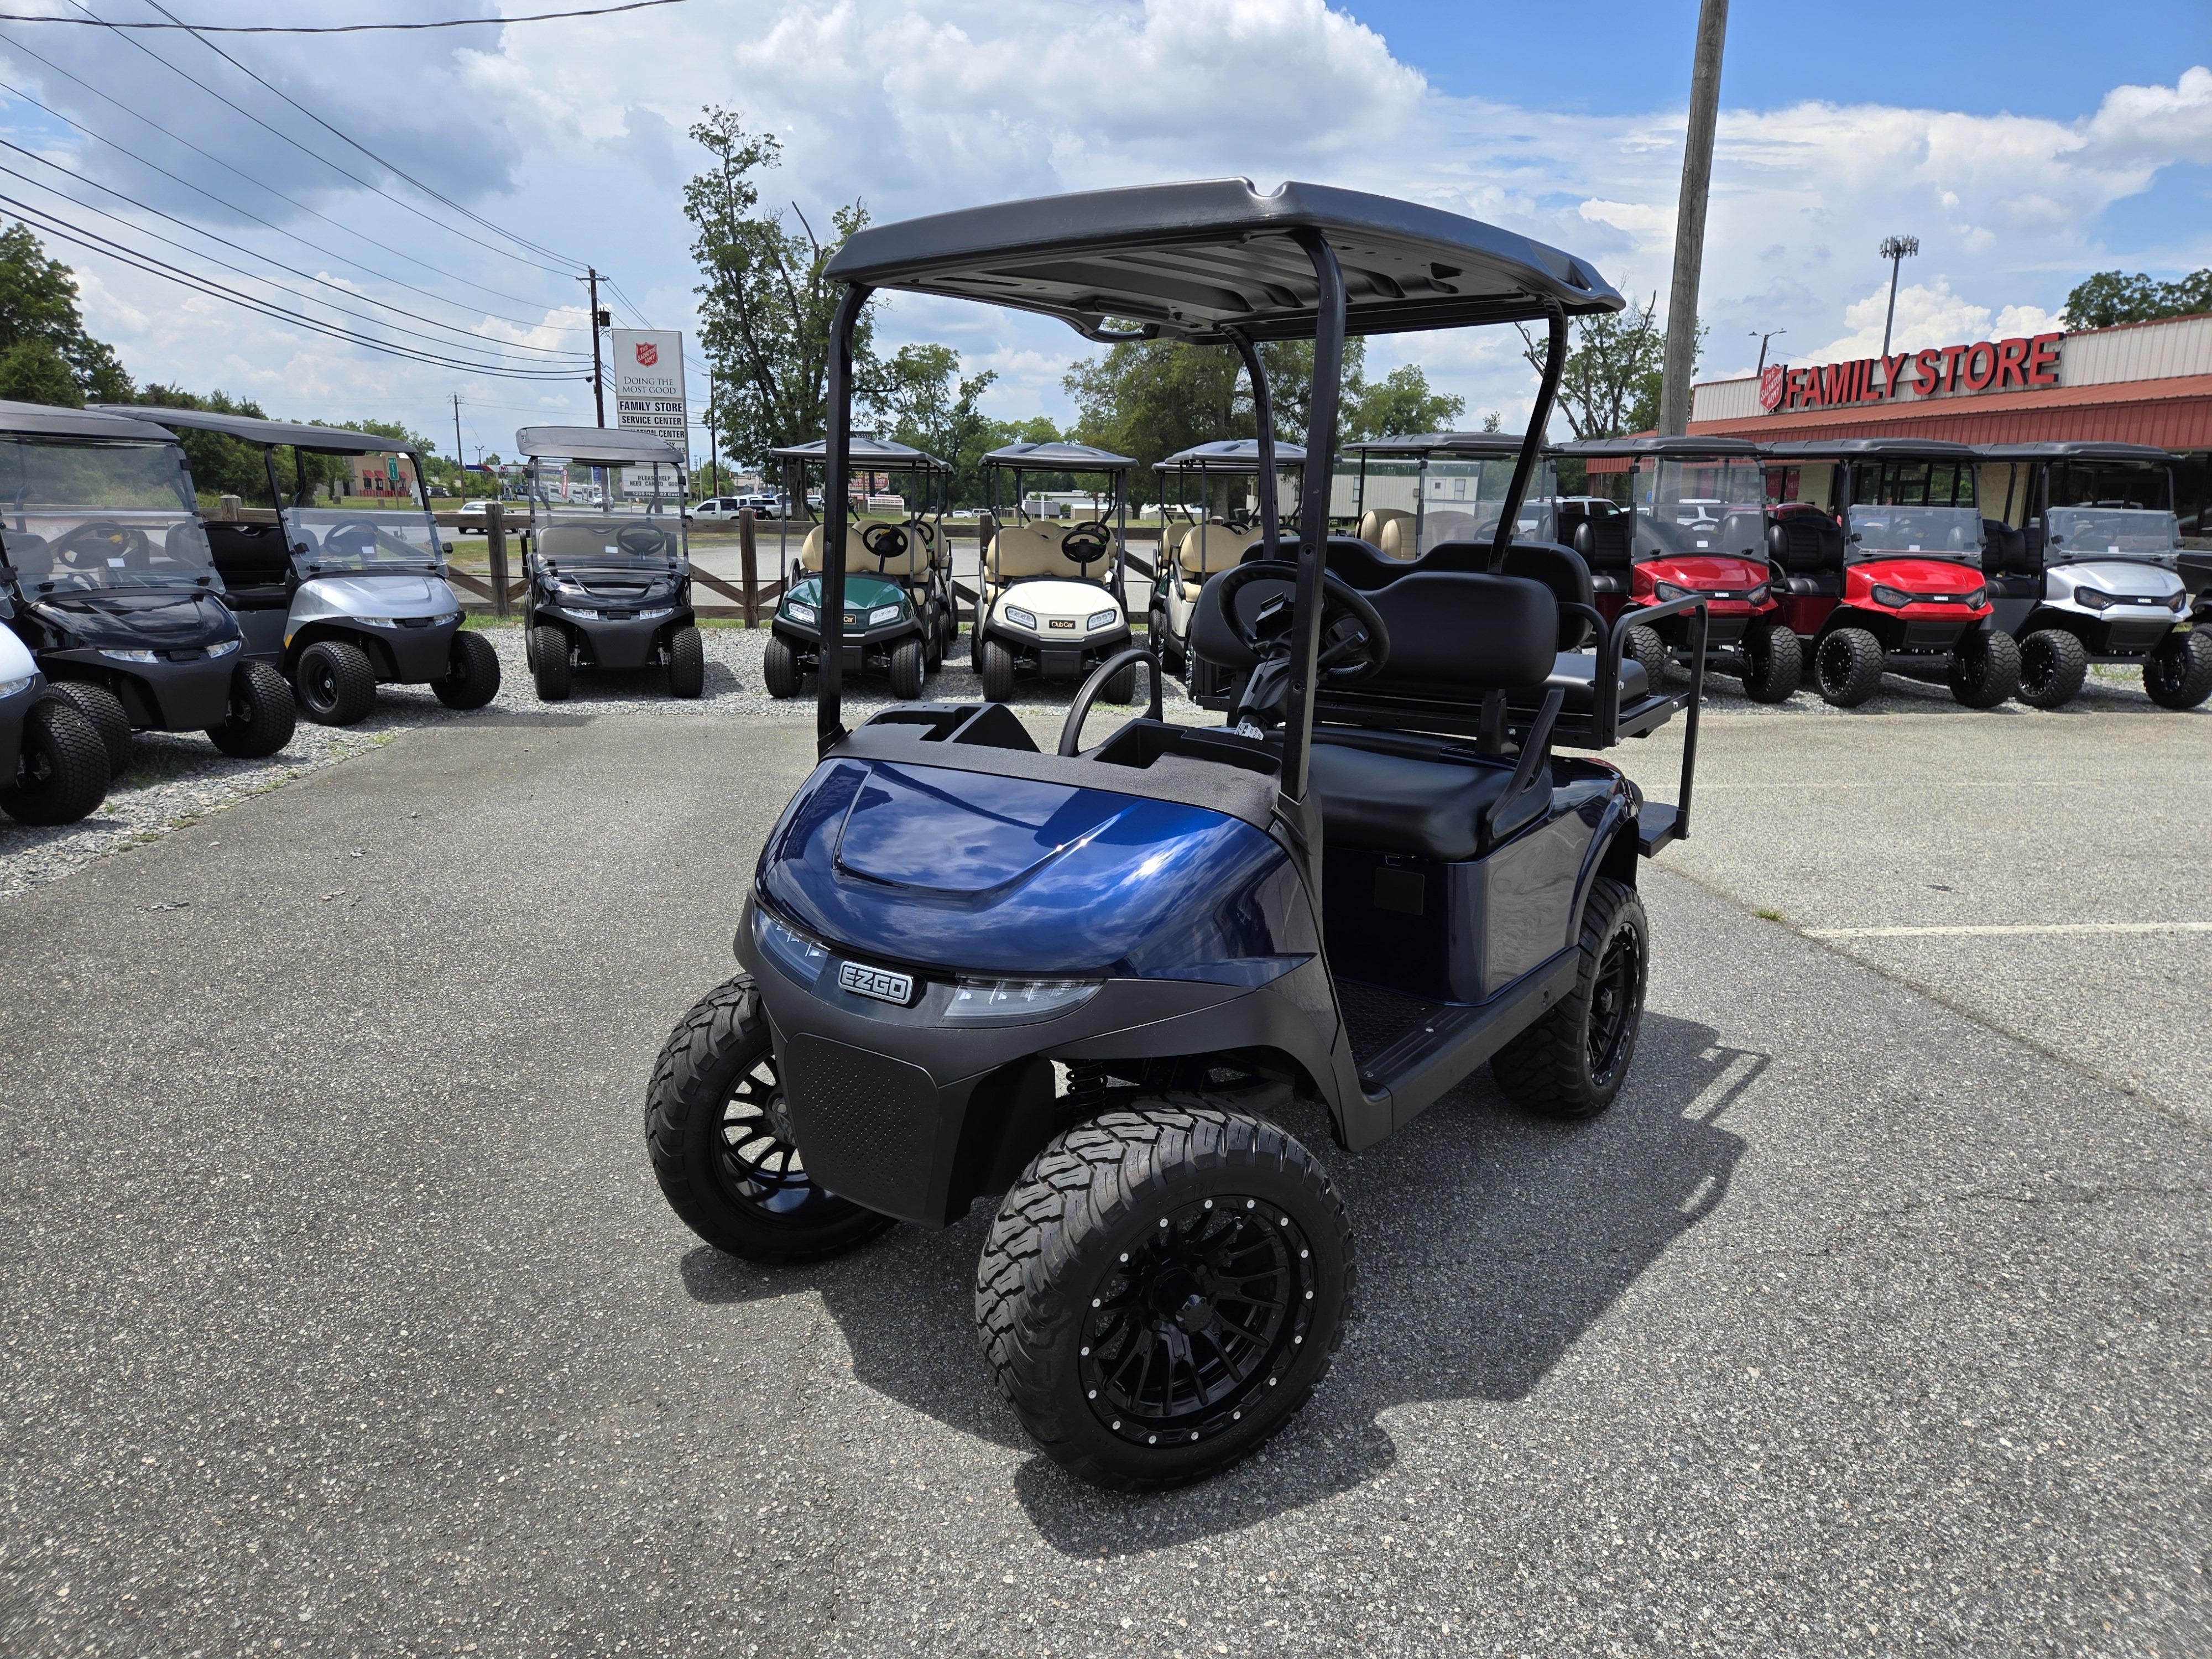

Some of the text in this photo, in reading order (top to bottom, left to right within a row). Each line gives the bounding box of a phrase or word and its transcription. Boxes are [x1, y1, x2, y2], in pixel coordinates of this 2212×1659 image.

[640, 345, 648, 353] THE
[644, 353, 655, 364] ARMY
[1786, 332, 2063, 408] FAMILY STORE
[624, 376, 655, 385] DOING
[1766, 368, 1775, 384] THE
[1766, 383, 1780, 407] ARMY
[619, 401, 682, 412] FAMILY STORE
[622, 416, 682, 425] SERVICE CENTER
[659, 430, 685, 438] CENTER
[841, 967, 906, 999] EZGO
